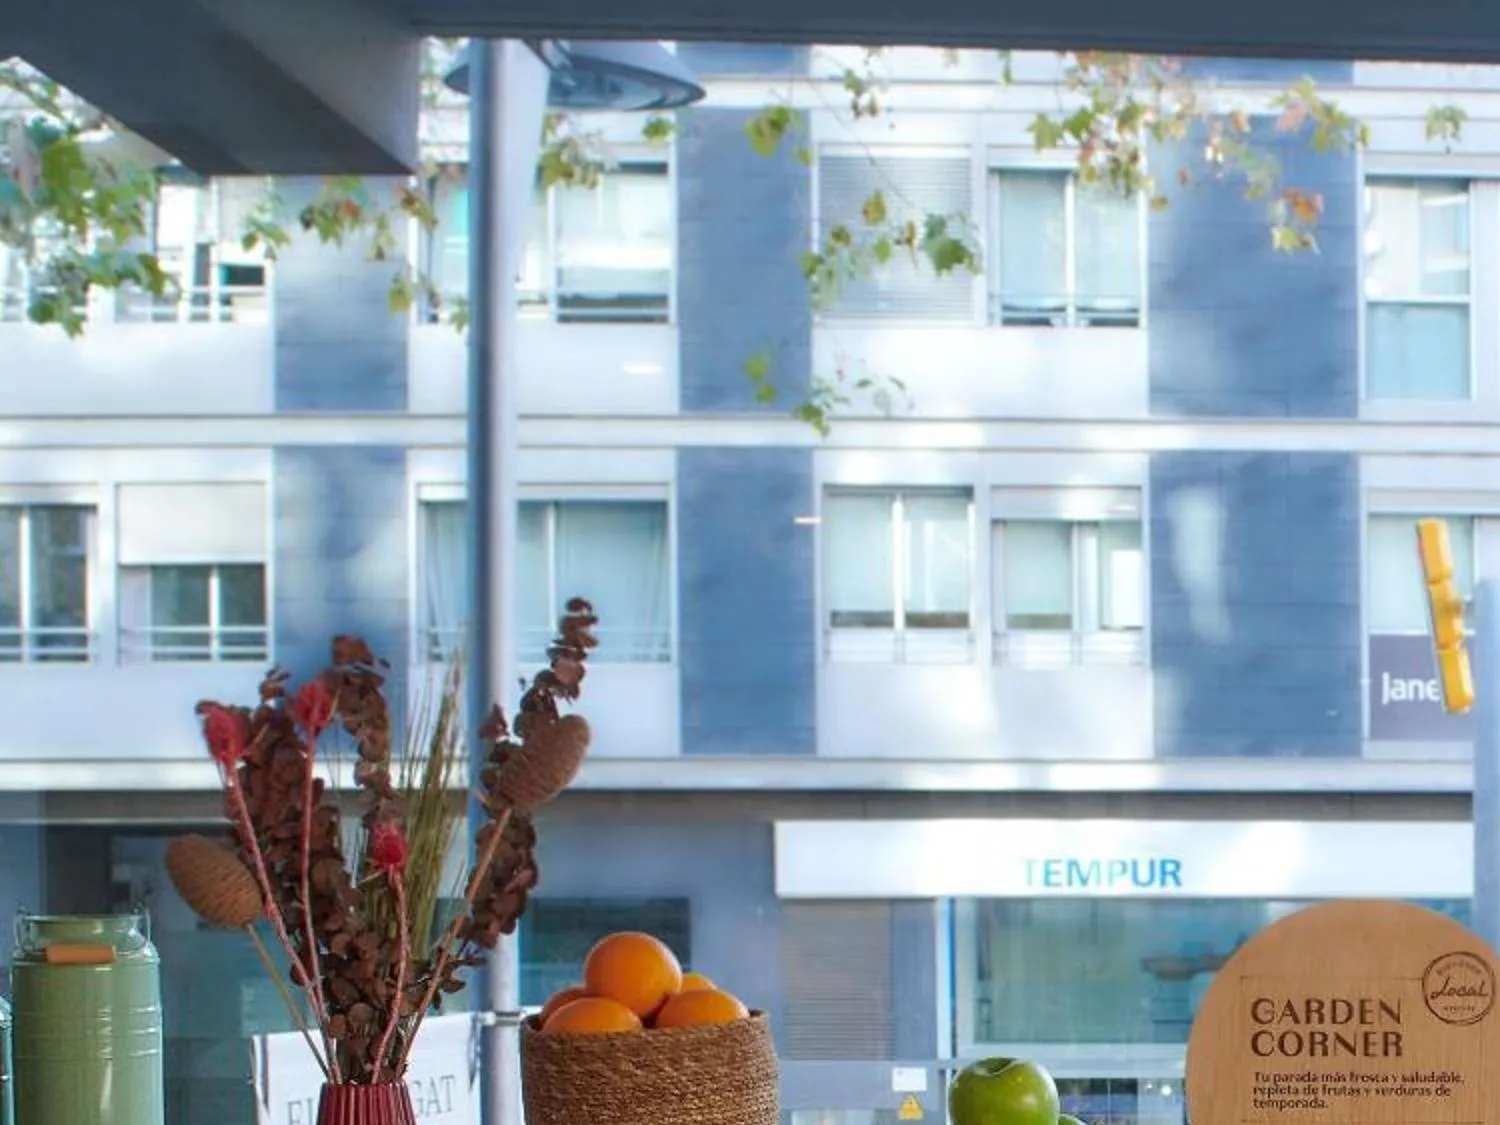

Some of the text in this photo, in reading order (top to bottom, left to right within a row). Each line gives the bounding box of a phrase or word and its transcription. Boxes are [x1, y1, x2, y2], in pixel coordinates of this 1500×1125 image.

[1021, 858, 1183, 888] TEMPUR
[1430, 975, 1489, 1000] Local
[1251, 997, 1402, 1025] GARDEN
[1251, 1030, 1403, 1057] CORNER
[1273, 1071, 1318, 1087] parada
[1303, 1084, 1319, 1096] de
[1322, 1084, 1361, 1097] frutas
[1435, 1084, 1451, 1097] de
